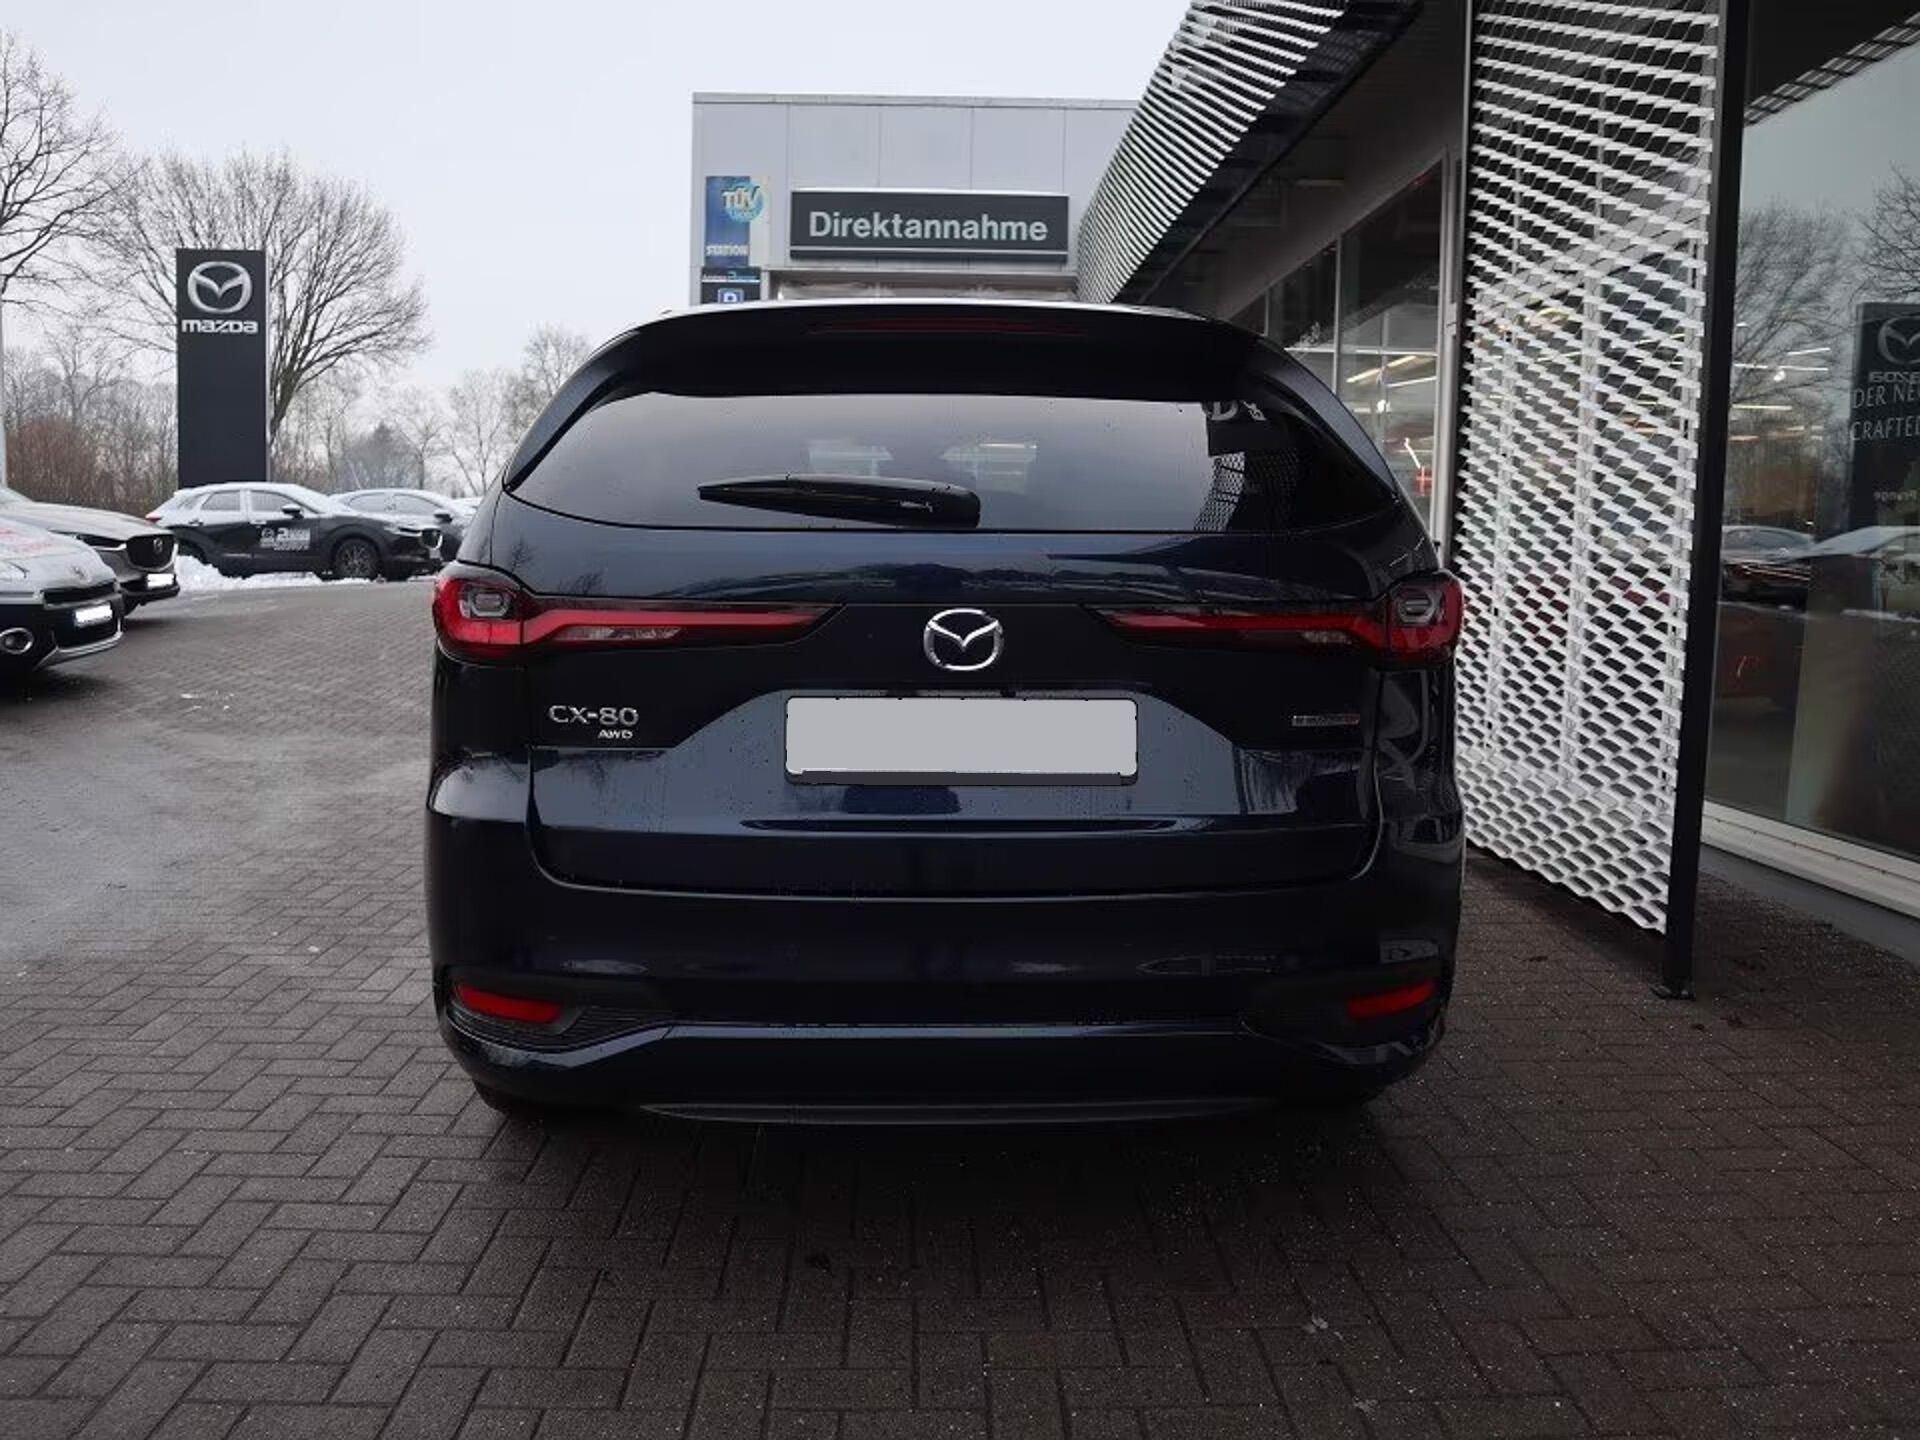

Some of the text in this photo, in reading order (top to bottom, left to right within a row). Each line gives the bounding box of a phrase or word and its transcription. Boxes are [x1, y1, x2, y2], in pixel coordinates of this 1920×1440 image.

[808, 210, 1049, 241] Direktannahme
[181, 319, 259, 334] mazda
[1853, 385, 1887, 409] DER
[549, 705, 639, 726] CX-80
[598, 729, 633, 739] AWD
